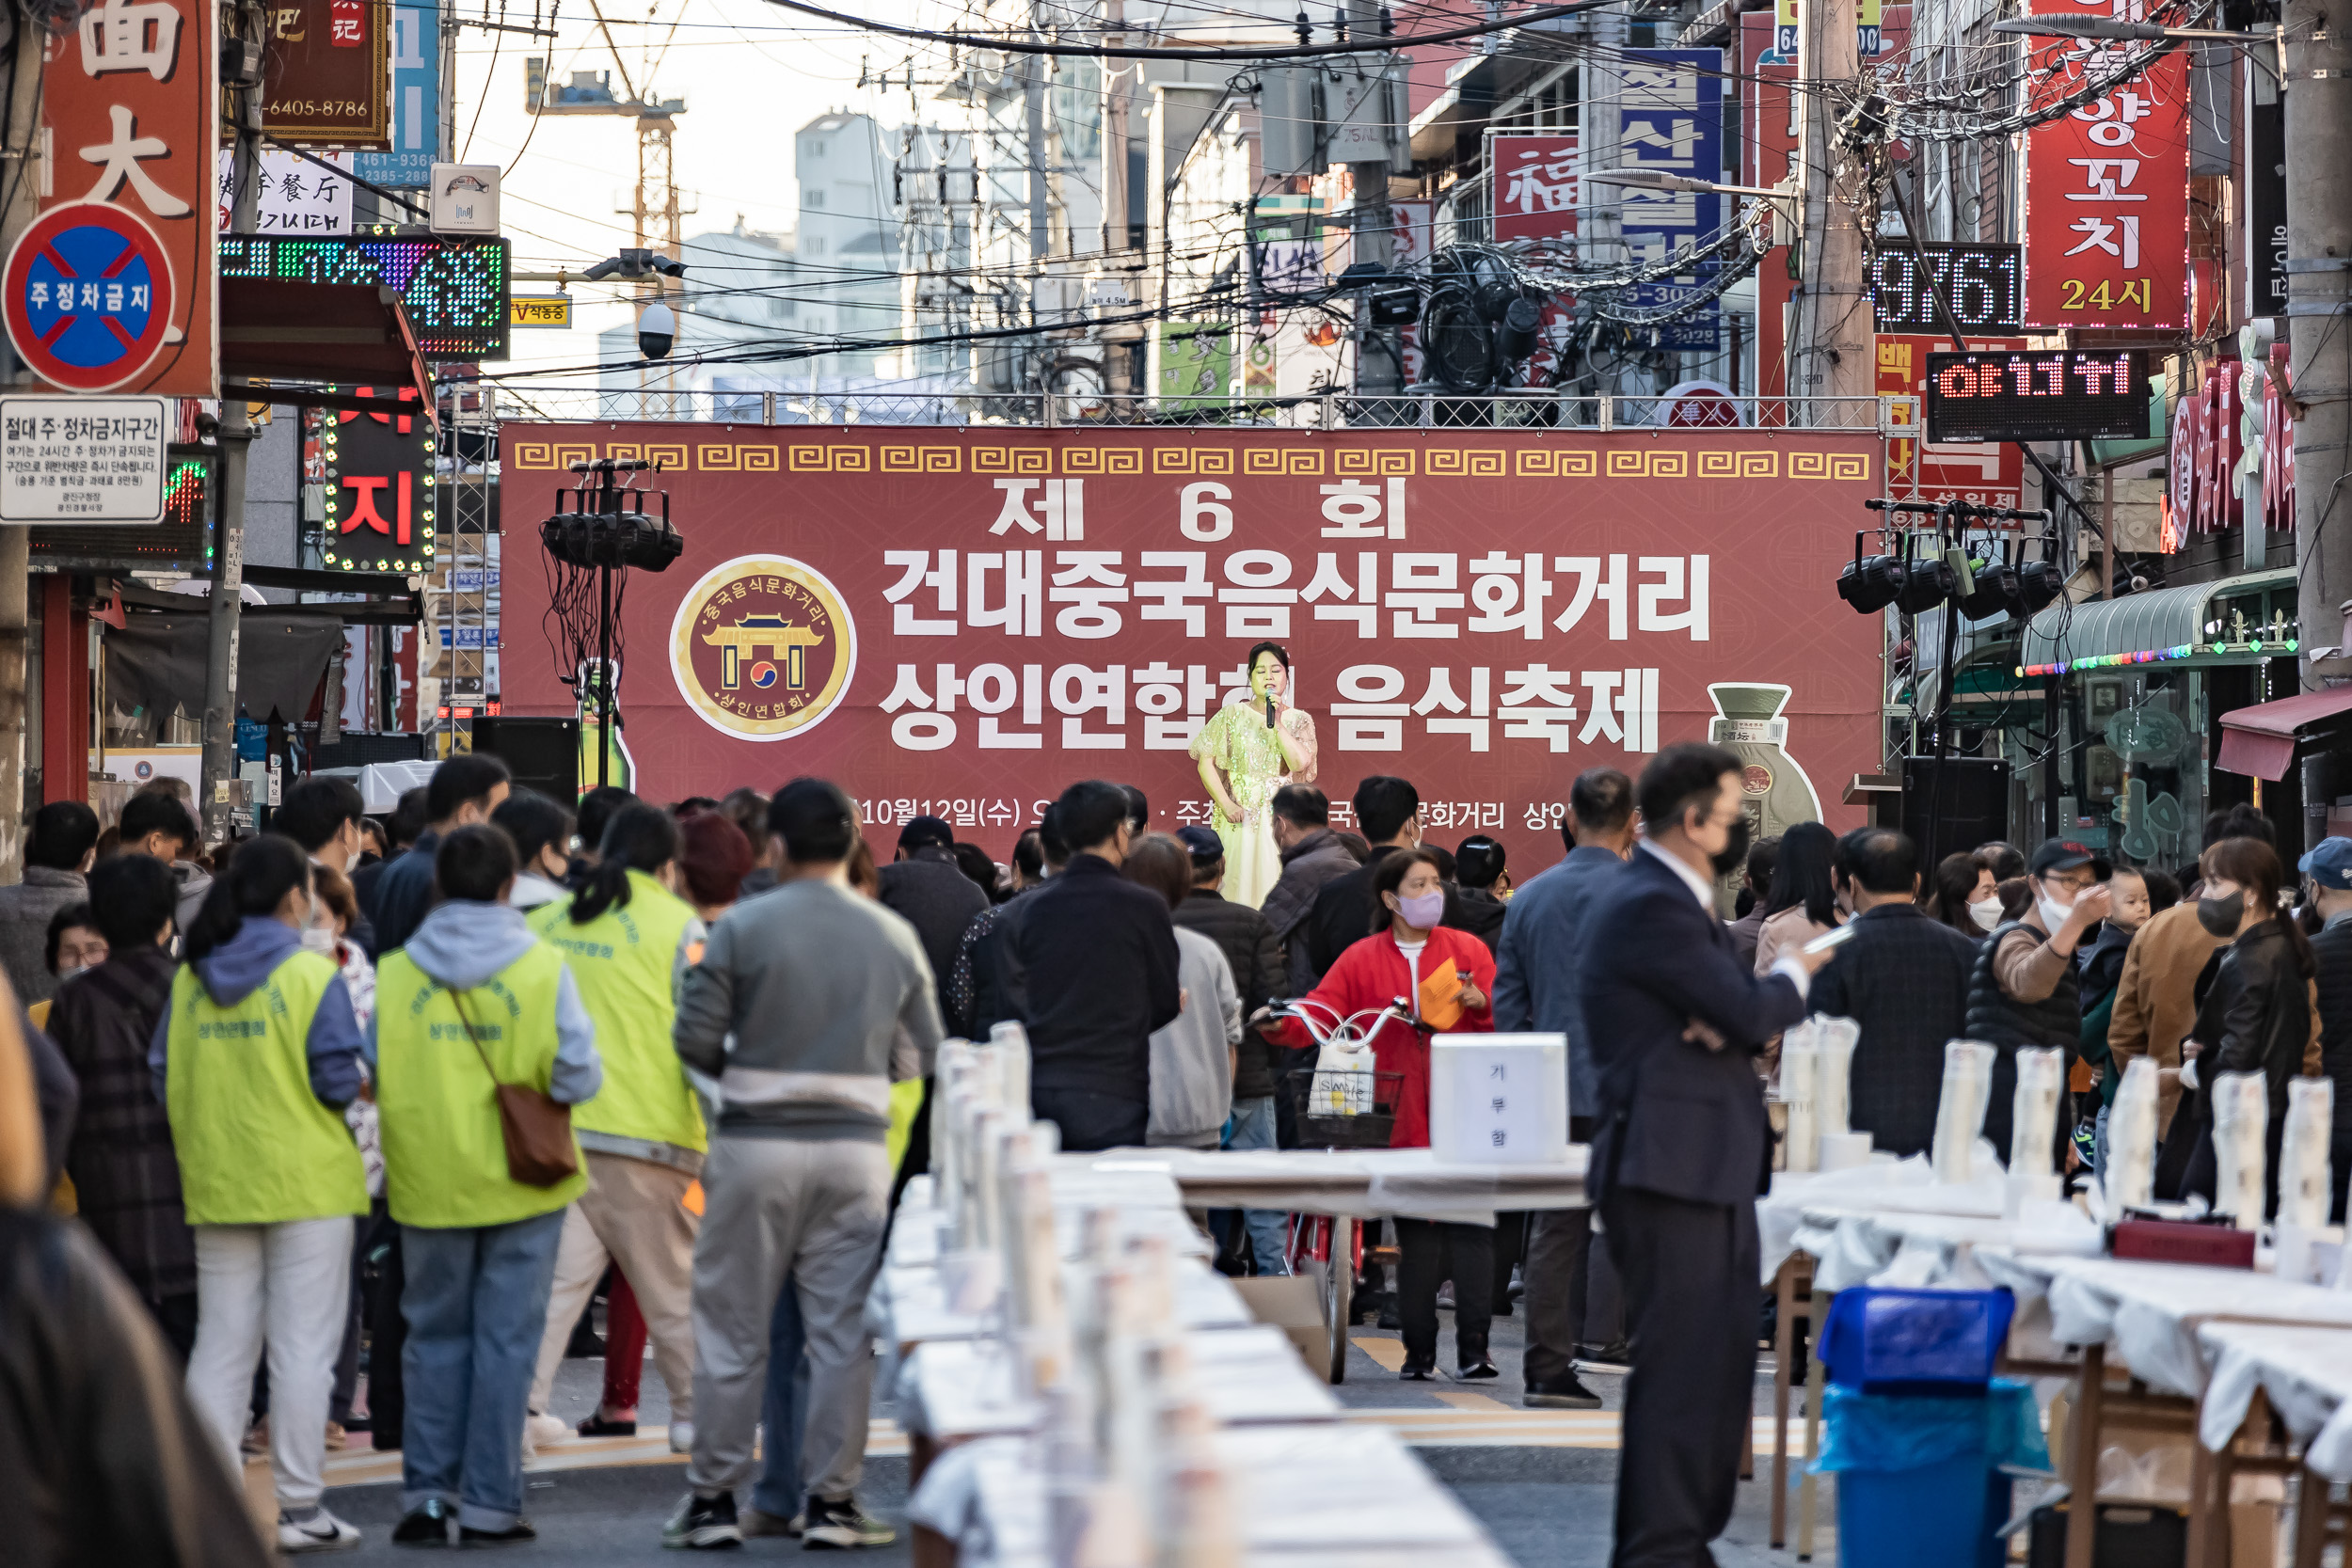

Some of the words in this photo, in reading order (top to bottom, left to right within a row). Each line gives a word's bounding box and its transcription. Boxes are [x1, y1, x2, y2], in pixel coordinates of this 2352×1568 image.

[30, 282, 149, 312] 주정차금지
[2060, 278, 2152, 314] 24시
[6, 417, 36, 441] 절대
[6, 460, 40, 473] 구간으로
[7, 445, 35, 458] 여기는
[40, 445, 71, 458] 24시간
[119, 445, 155, 458] 금지되는
[988, 478, 1085, 542] 제
[1179, 482, 1234, 542] 6
[1319, 478, 1406, 540] 회
[703, 577, 826, 623] 중국음식문화거리
[882, 548, 1710, 641] 건대중국음식문화거리
[719, 693, 804, 719] 상인연합회
[1330, 663, 1660, 752] 음식축제
[861, 799, 1020, 827] 10월12일(수)
